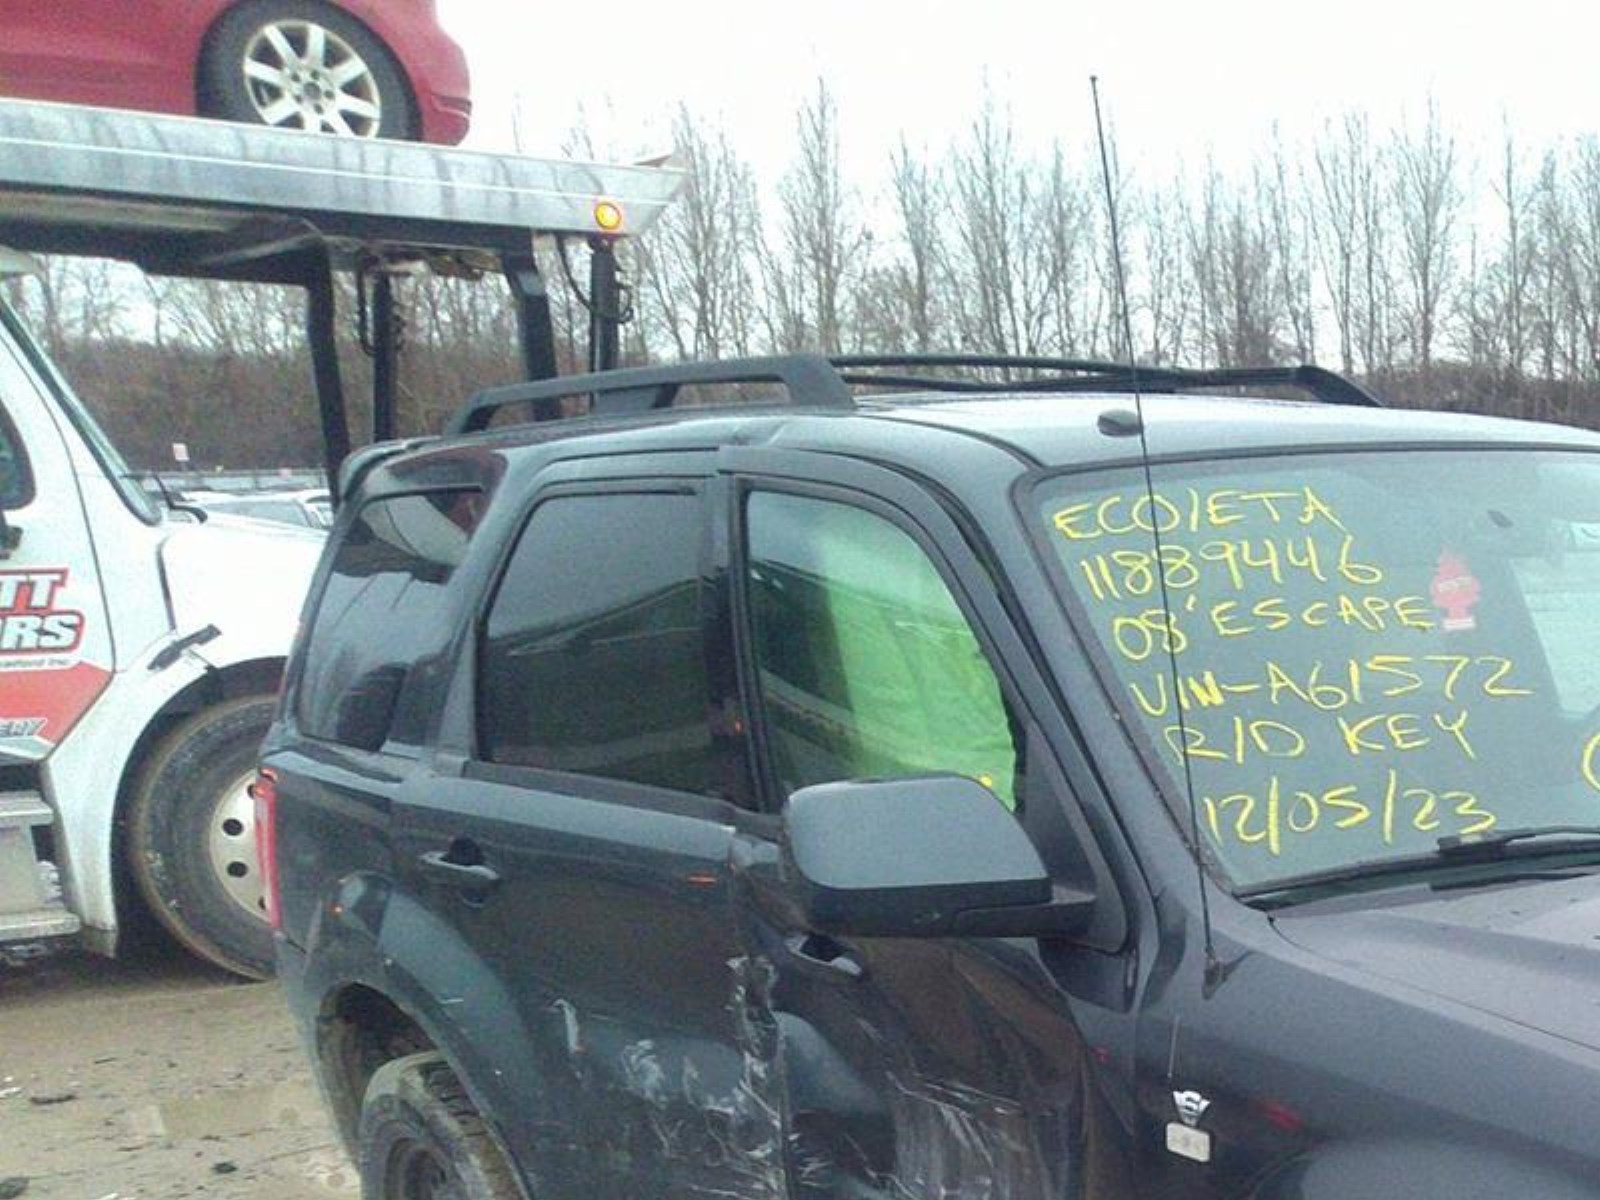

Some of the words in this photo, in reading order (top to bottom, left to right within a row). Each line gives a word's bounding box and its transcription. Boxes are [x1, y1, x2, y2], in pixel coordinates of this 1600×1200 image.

[1079, 534, 1384, 601] 11889446
[0, 572, 65, 610] TT
[0, 613, 80, 650] RS
[1210, 594, 1436, 636] ESCAPE
[1337, 709, 1477, 760] KEY
[1204, 768, 1498, 855] 12/05/23
